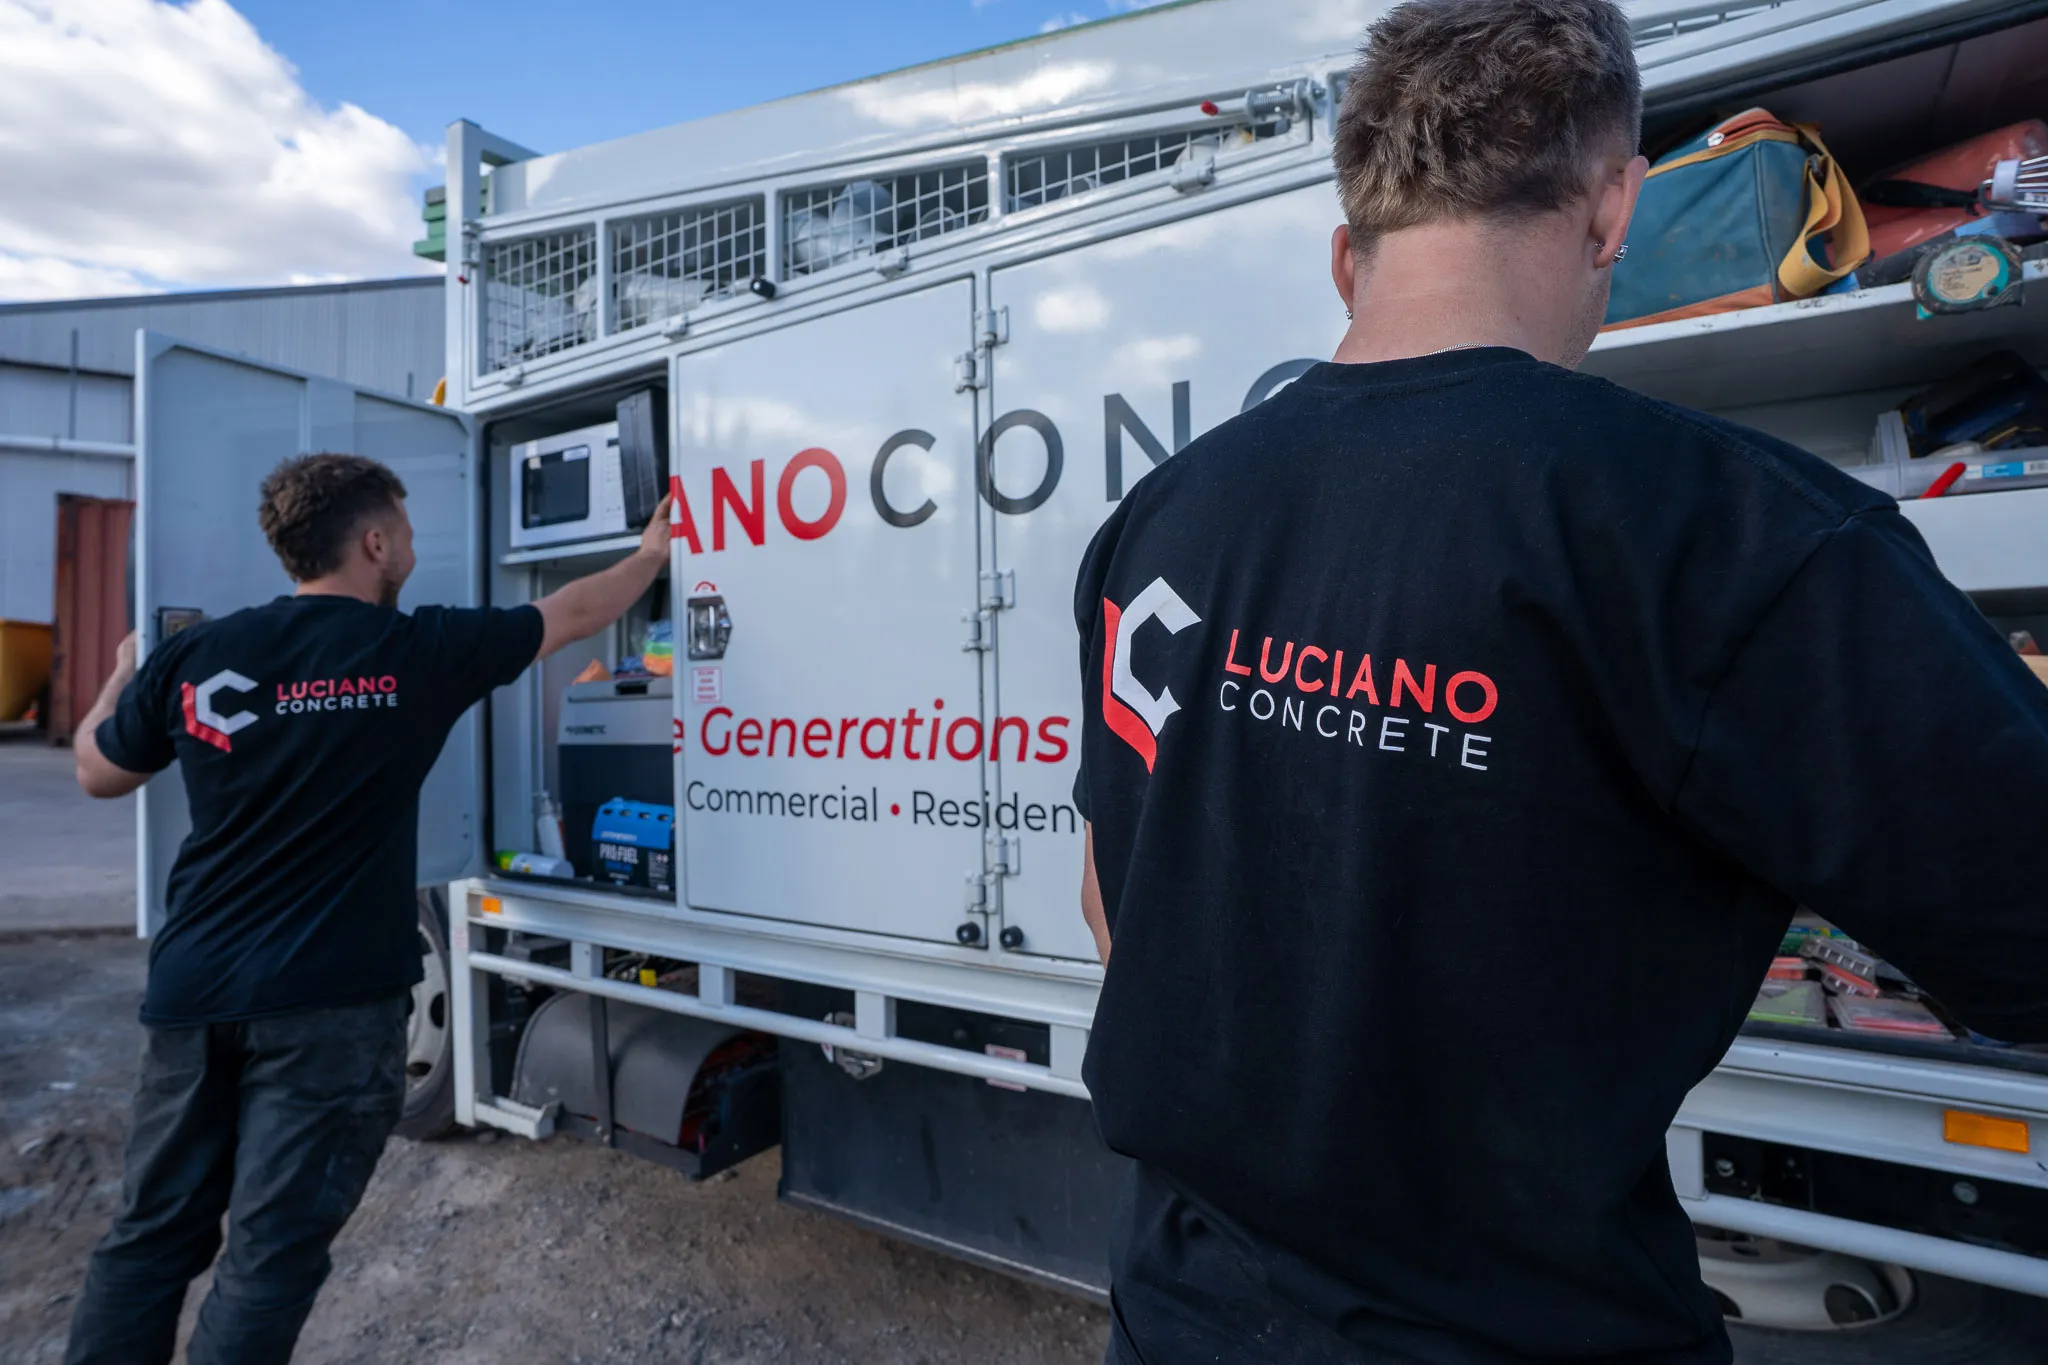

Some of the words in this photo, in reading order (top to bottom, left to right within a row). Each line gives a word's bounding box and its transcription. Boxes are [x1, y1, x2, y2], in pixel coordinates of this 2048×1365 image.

[870, 358, 1325, 528] CON
[275, 693, 398, 715] CONCRETE
[276, 675, 397, 701] LUCIANO
[1224, 628, 1498, 723] LUCIANO
[700, 698, 1070, 763] Generations
[1219, 680, 1492, 771] CONCRETE
[687, 780, 878, 821] Commercial
[912, 790, 1086, 834] Residen
